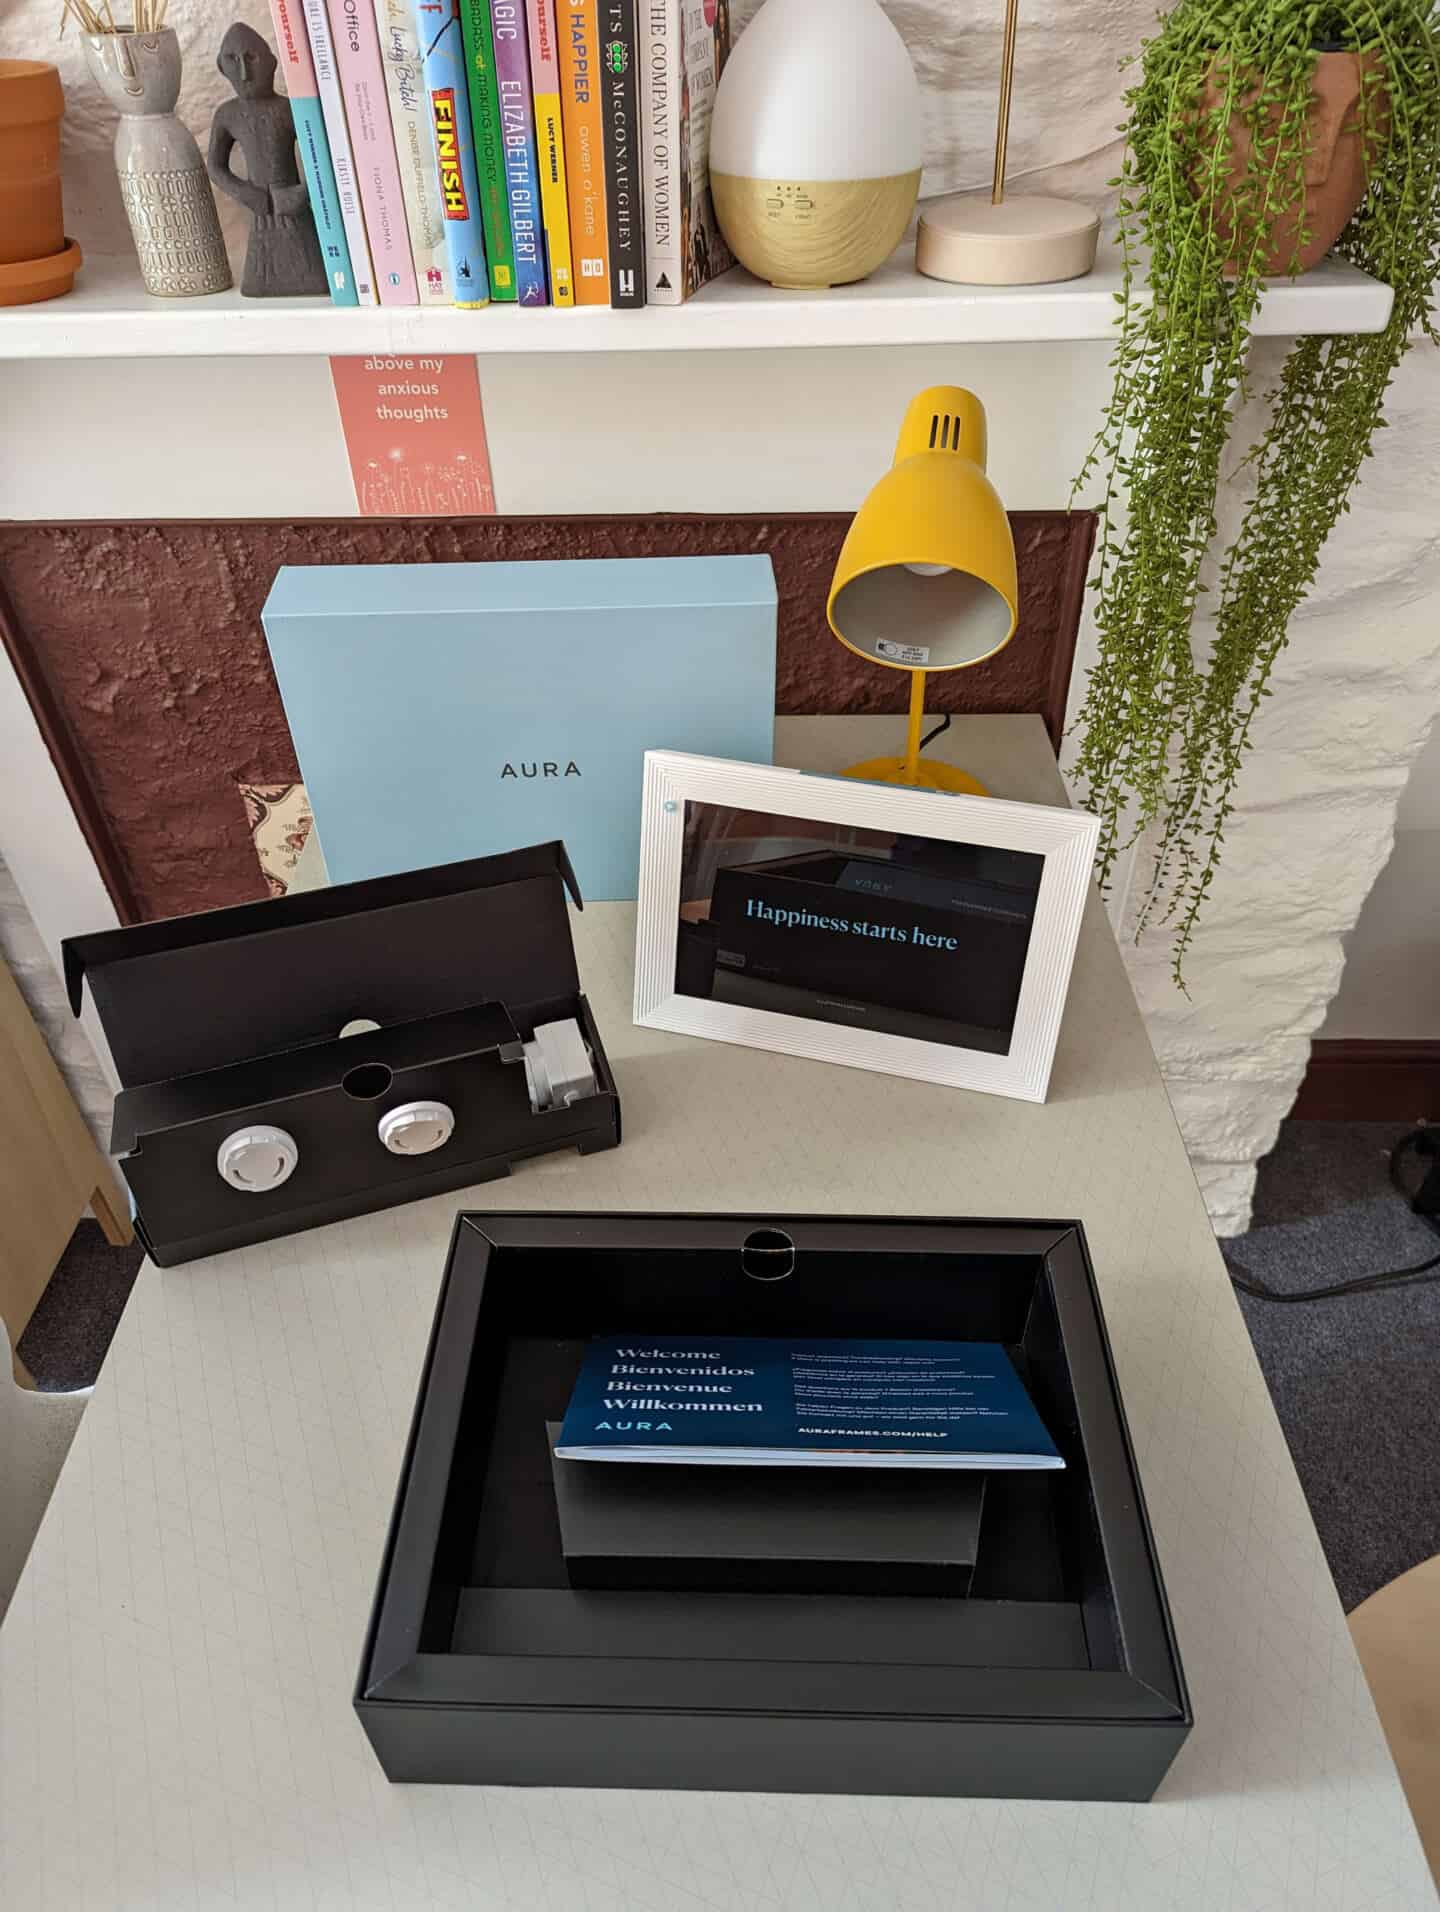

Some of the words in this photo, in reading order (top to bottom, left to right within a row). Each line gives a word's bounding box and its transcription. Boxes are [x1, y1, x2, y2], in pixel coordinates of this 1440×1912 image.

[278, 0, 299, 64] ourself
[343, 0, 361, 52] Office
[651, 0, 666, 36] THE
[389, 26, 408, 62] Lucky
[570, 14, 590, 103] HAPPIER
[651, 43, 669, 141] COMPANY
[501, 80, 529, 184] ELIZABETH
[547, 117, 556, 141] LUCY
[433, 99, 464, 212] FINISH
[549, 142, 558, 183] WERNER
[612, 79, 633, 250] McCONAUGHEY
[653, 145, 669, 169] OF
[512, 189, 536, 265] GILBERT
[654, 175, 671, 247] WOMEN
[365, 355, 414, 370] above
[420, 359, 443, 374] my
[378, 380, 439, 395] anxious
[376, 404, 448, 423] thoughts
[501, 761, 582, 779] AURA
[746, 898, 849, 932] Happiness
[852, 920, 907, 942] starts
[912, 926, 958, 950] here
[611, 1364, 756, 1376] Bienvenidos
[616, 1349, 721, 1360] Welcome
[607, 1380, 733, 1393] Bienvenue
[603, 1399, 764, 1412] Willkommen
[595, 1421, 673, 1431] AURA
[798, 1427, 949, 1438] AURAFRAMES.COM/HELP
